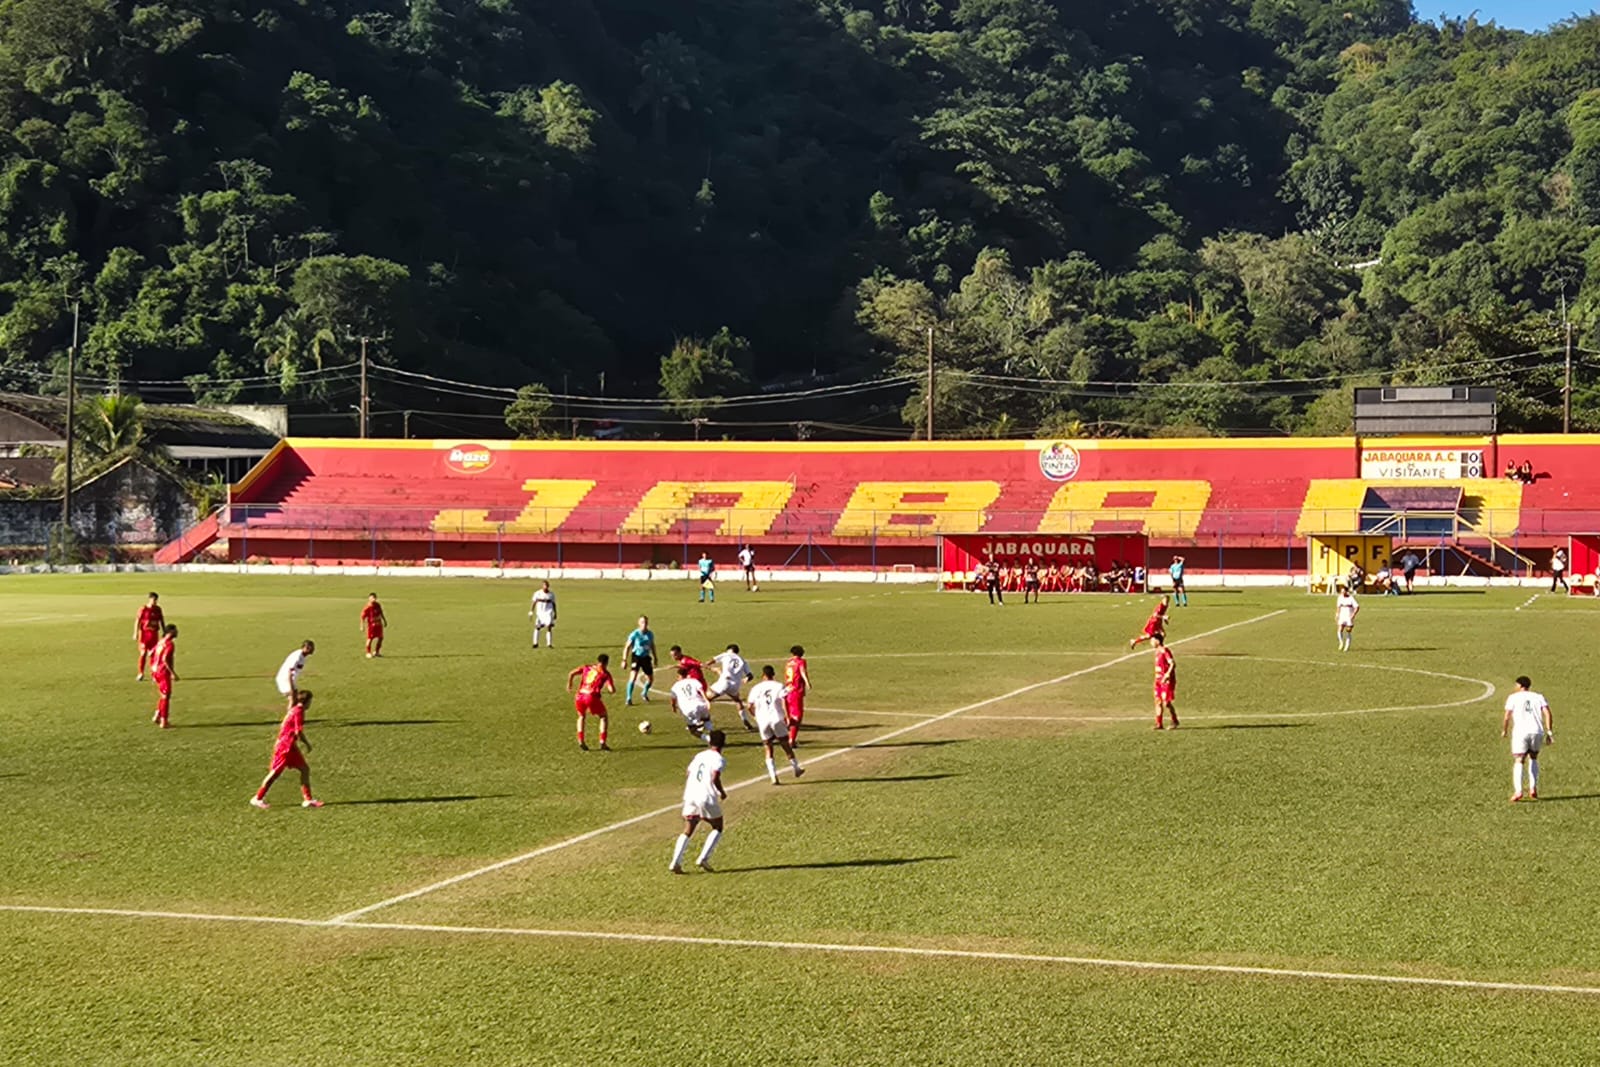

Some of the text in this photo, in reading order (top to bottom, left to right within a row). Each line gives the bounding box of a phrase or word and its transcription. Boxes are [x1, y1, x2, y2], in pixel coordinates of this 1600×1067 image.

[1364, 452, 1457, 463] JABAQUARA A.C.
[1469, 452, 1479, 464] 0
[1379, 467, 1446, 478] VISITANTE
[1469, 465, 1479, 477] 0
[982, 542, 1095, 556] JABAQUARA
[764, 689, 773, 705] 5
[696, 763, 705, 782] 6
